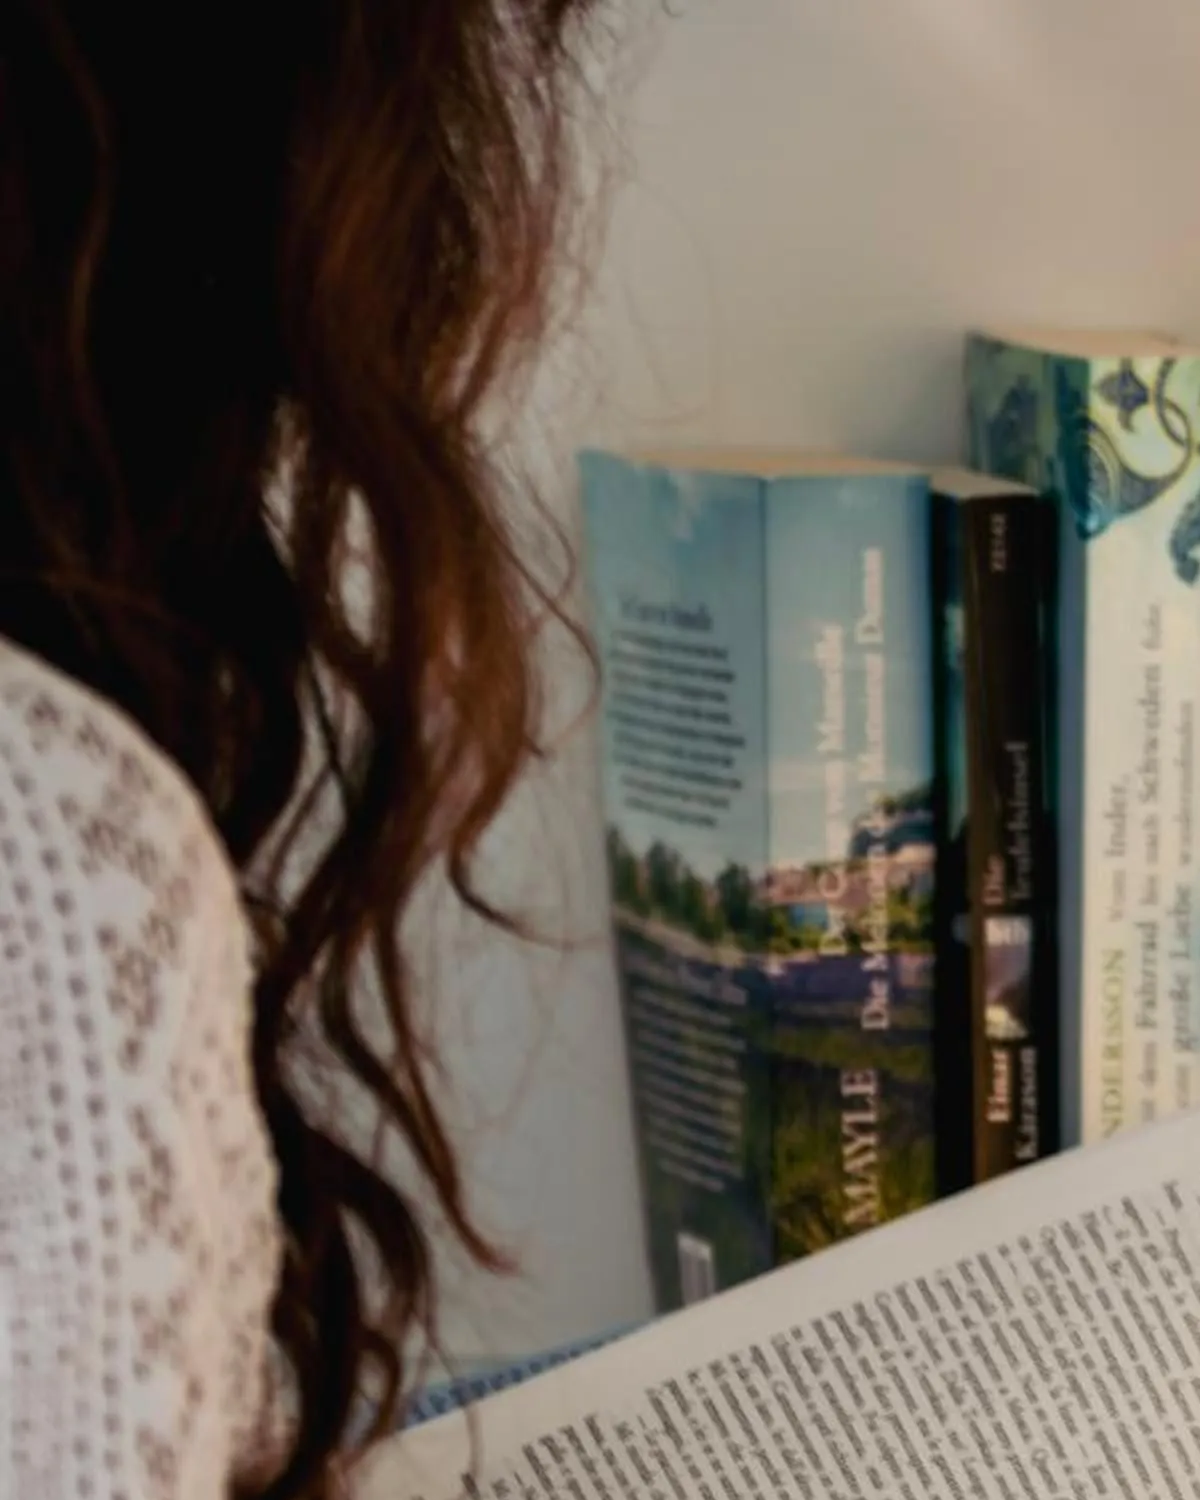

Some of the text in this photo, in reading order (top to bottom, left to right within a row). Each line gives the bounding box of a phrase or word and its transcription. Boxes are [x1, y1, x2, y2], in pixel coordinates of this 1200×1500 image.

[1136, 665, 1163, 804] Schweden
[982, 856, 1007, 907] Die
[1167, 884, 1193, 960] Liebe
[859, 981, 891, 1029] Die
[1132, 922, 1159, 1030] Fahrrad
[1169, 974, 1196, 1054] große
[1100, 948, 1124, 1140] NDERSSON
[987, 1048, 1012, 1123] Einar
[840, 1067, 881, 1227] MAYLE
